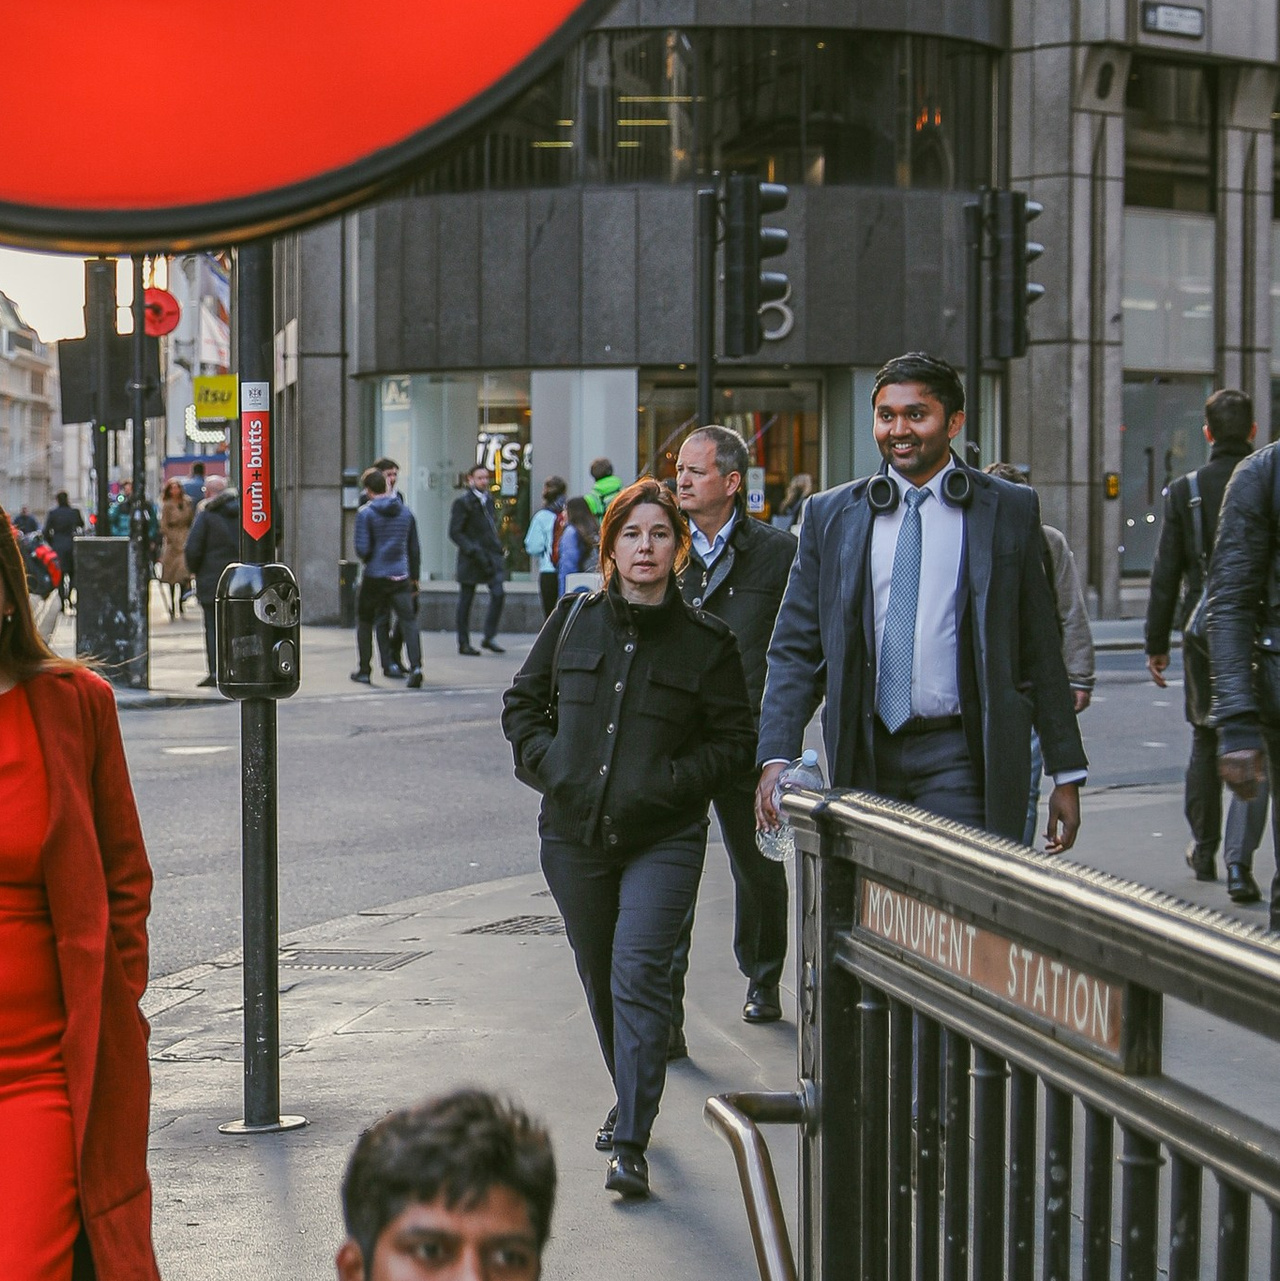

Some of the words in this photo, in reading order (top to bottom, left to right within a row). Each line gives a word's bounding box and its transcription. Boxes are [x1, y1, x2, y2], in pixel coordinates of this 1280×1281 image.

[197, 384, 233, 404] itsu
[868, 883, 976, 976] MONUMENT
[1008, 943, 1110, 1043] STATION
